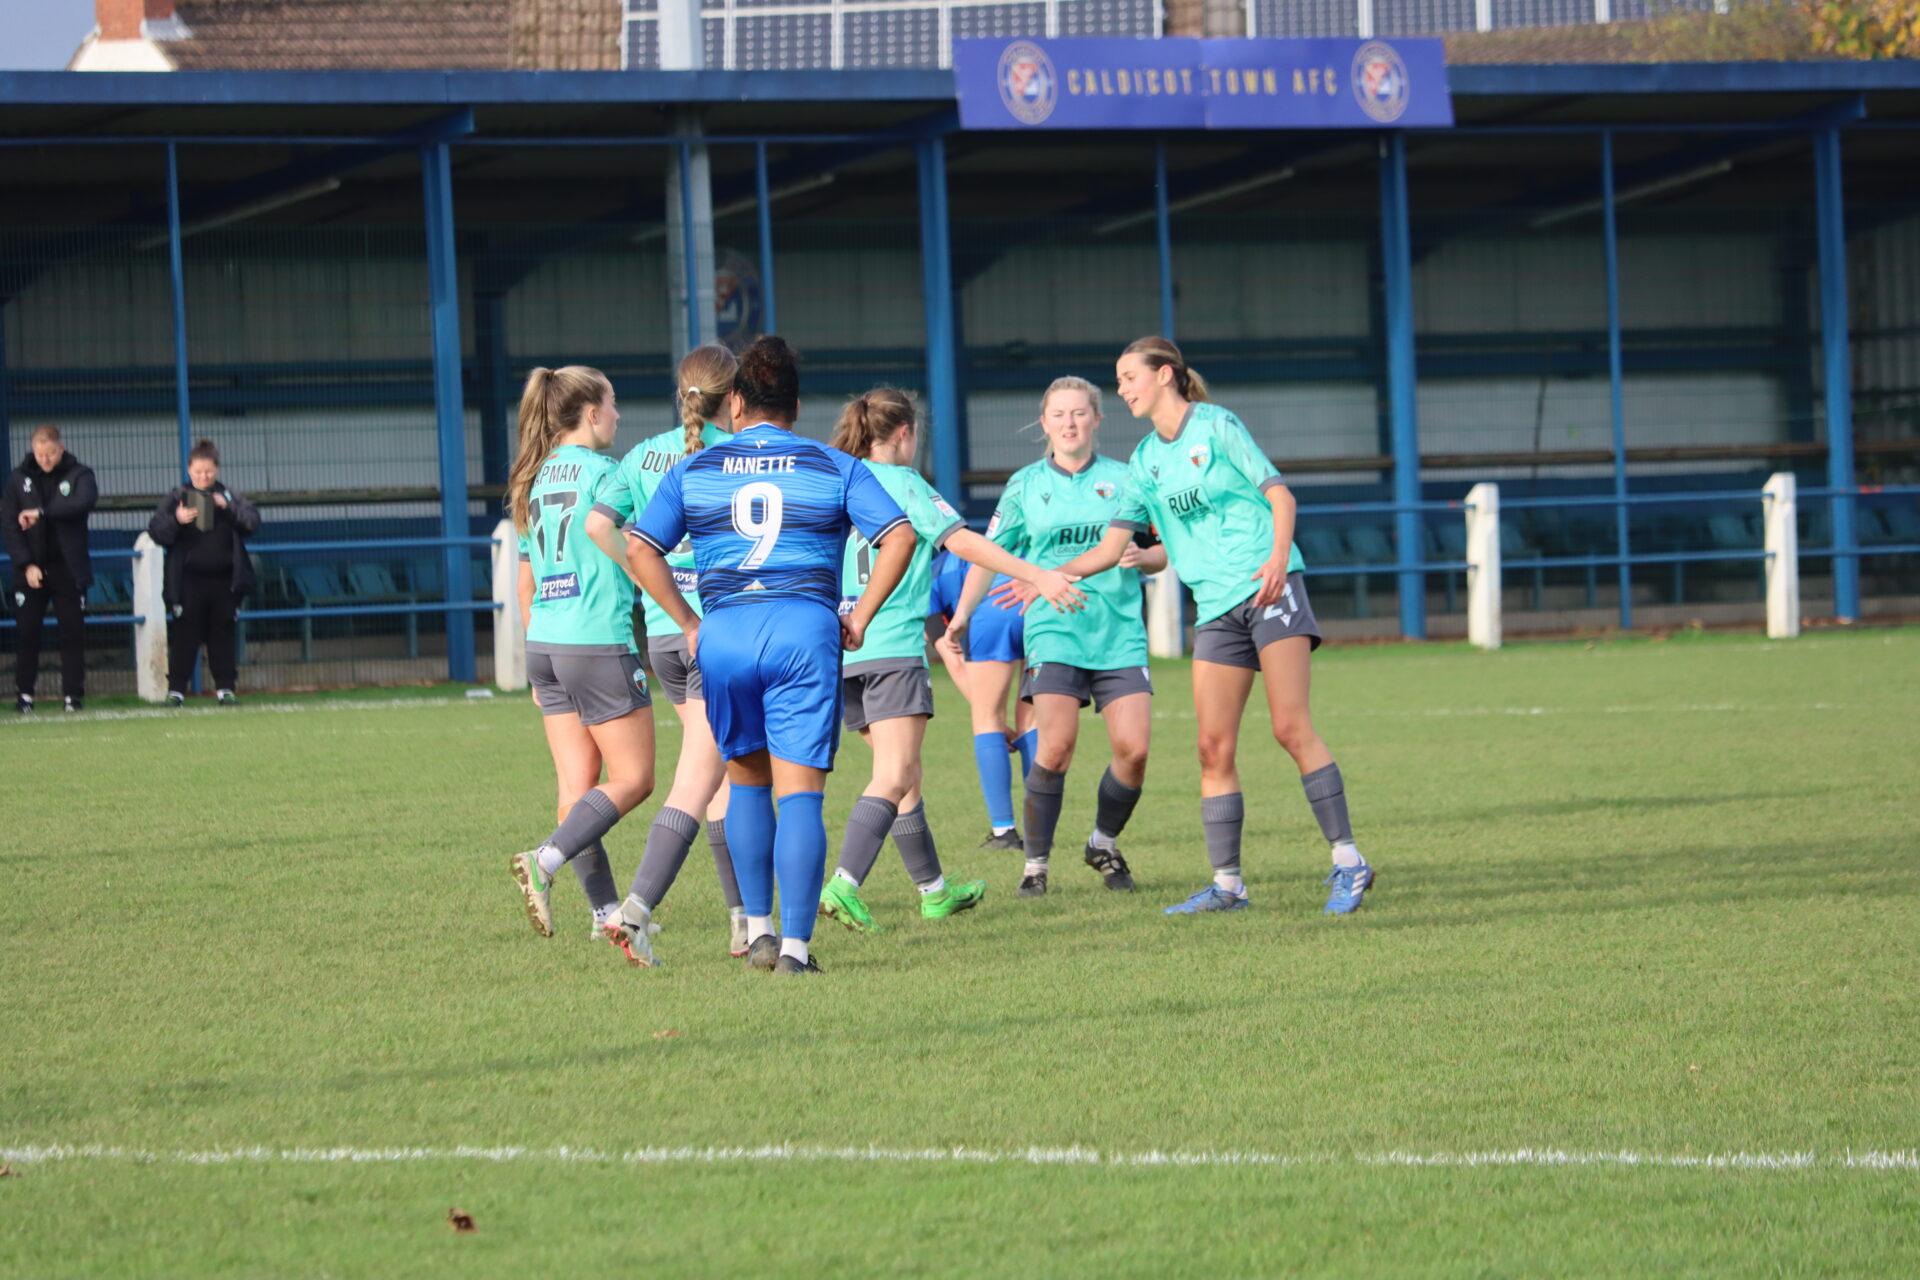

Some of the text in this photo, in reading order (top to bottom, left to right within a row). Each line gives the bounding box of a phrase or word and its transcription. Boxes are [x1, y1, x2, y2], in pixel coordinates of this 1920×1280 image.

[1067, 68, 1338, 96] CALDICOT TOWN AFC
[641, 450, 687, 473] DUN
[722, 456, 796, 475] NANETTE
[1168, 488, 1203, 516] RUK
[731, 482, 783, 570] 9
[1059, 524, 1104, 544] RUK
